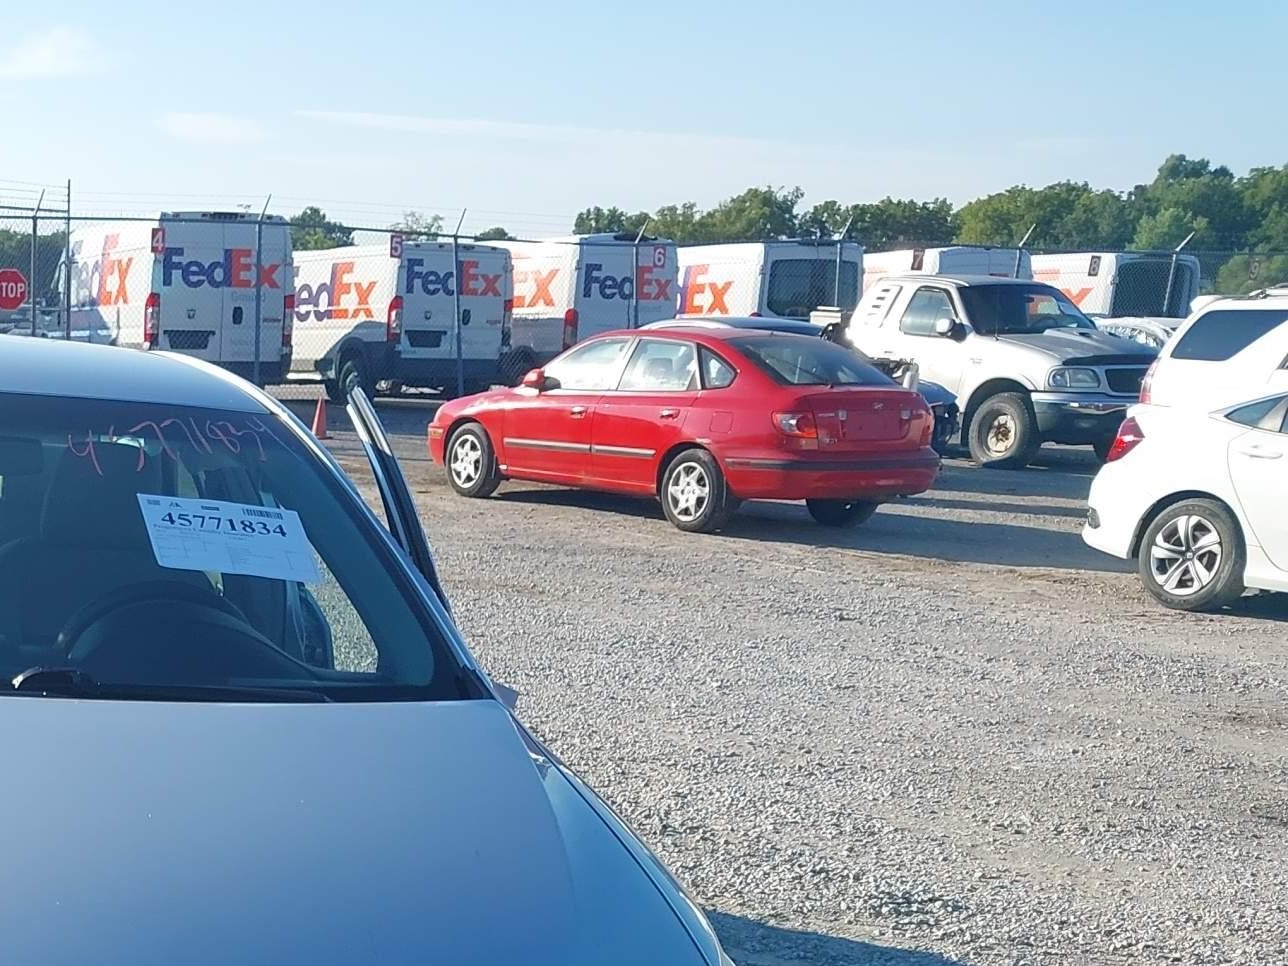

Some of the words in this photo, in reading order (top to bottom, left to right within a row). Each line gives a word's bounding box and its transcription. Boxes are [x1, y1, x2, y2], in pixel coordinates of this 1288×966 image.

[152, 231, 164, 252] 4
[391, 237, 401, 257] 5
[162, 247, 281, 289] FedEx
[654, 248, 665, 267] 6
[1089, 257, 1100, 274] 8
[406, 258, 502, 297] FedEx
[583, 263, 672, 301] FedEx
[294, 261, 377, 322] edEx
[161, 511, 288, 538] 45771834
